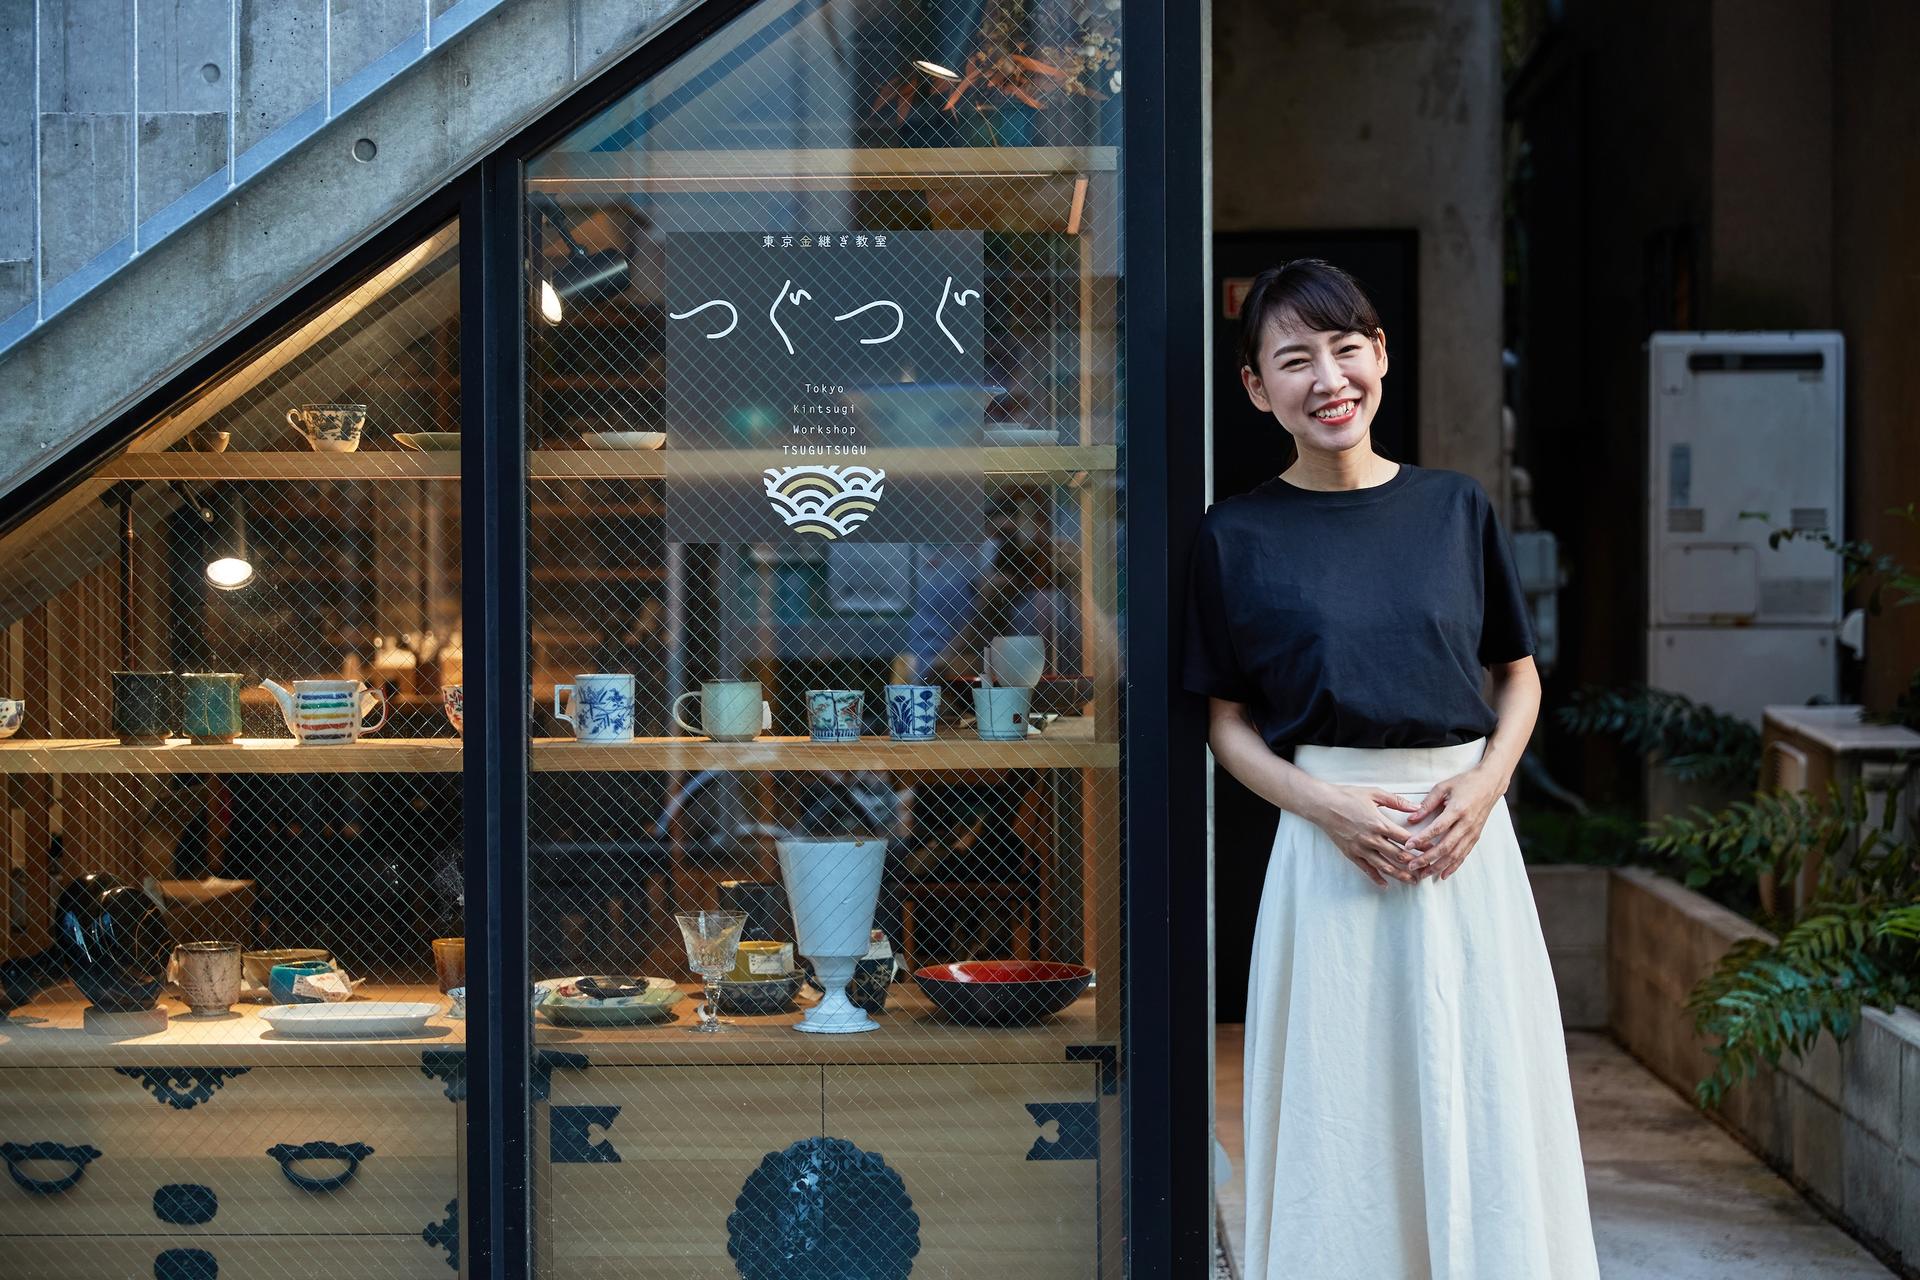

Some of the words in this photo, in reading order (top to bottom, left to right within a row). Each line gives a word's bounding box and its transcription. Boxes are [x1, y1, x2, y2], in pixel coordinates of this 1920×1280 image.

[762, 234, 887, 248] 東京金継ぎ教室
[668, 276, 981, 355] つぐつぐ
[804, 383, 844, 395] Tokyo
[793, 404, 855, 416] Kintsugi
[792, 424, 856, 436] Workshop
[782, 445, 867, 456] TSUGUTSUGU
